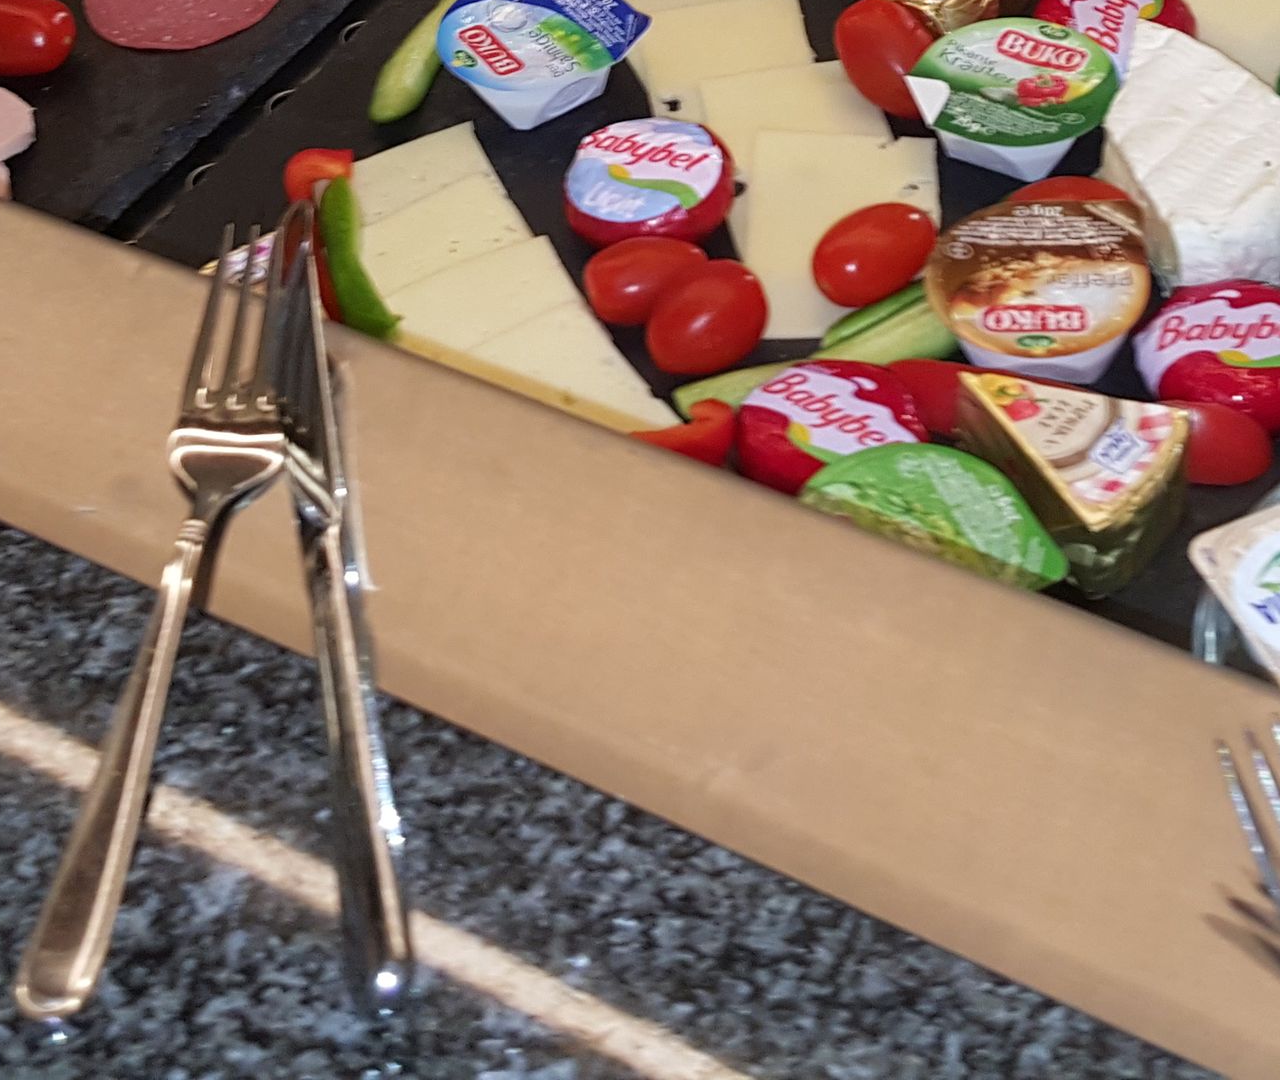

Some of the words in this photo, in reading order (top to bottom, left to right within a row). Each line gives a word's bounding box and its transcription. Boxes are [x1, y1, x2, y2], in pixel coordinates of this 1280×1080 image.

[464, 27, 518, 74] BUKO
[527, 29, 582, 74] Sahnige
[1001, 32, 1084, 70] BUKO
[576, 126, 710, 172] Babybel
[985, 308, 1083, 331] BUKO
[762, 372, 889, 447] Babybe
